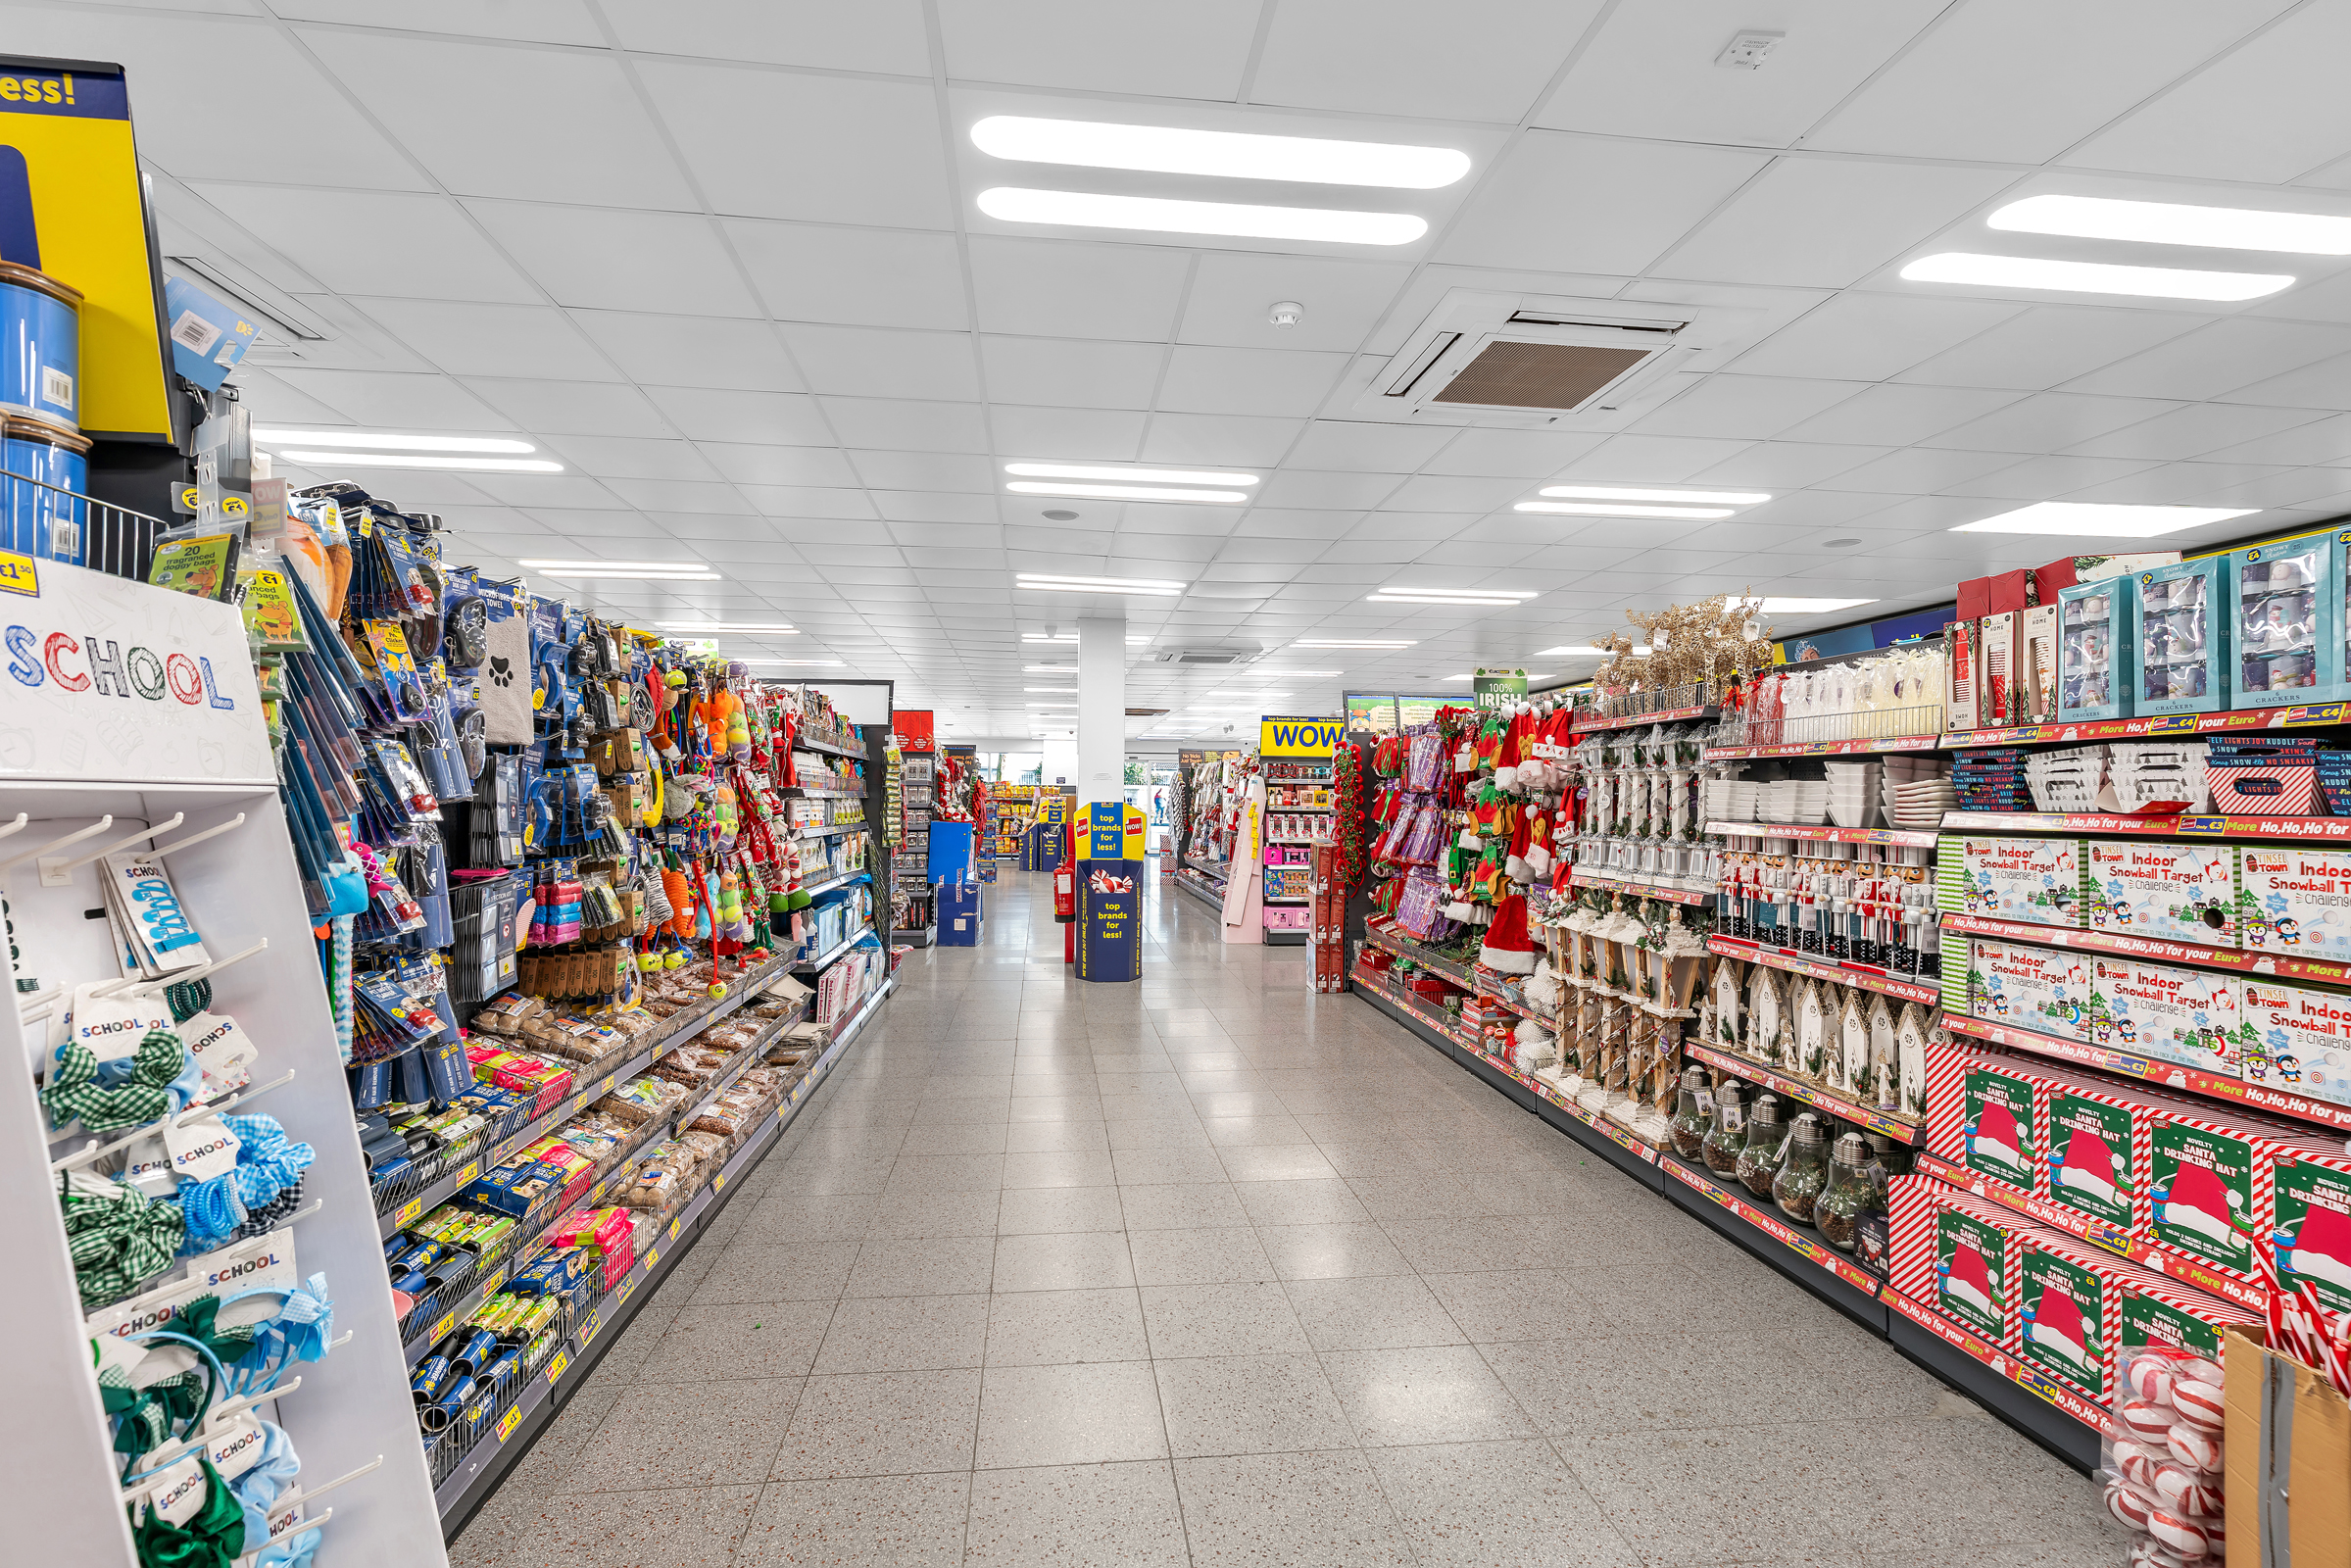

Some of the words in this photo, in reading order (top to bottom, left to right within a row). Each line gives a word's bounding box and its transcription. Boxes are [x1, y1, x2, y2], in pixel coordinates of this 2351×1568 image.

[184, 545, 201, 557] 20
[164, 562, 192, 571] doggy
[193, 558, 216, 566] bags
[166, 552, 216, 565] fragranced
[487, 599, 505, 610] TOWEL
[5, 624, 235, 710] SCHOOL
[1489, 683, 1513, 693] 100%
[1479, 693, 1522, 707] IRISH
[2256, 695, 2300, 704] CRACKERS
[2321, 708, 2339, 717] €4
[2099, 725, 2124, 734] More
[2180, 718, 2194, 727] €4
[2198, 716, 2226, 730] your
[2228, 716, 2256, 726] Euro
[1273, 725, 1345, 748] WOW
[1100, 815, 1114, 824] top
[2119, 819, 2142, 831] your
[2144, 819, 2168, 829] Euro
[1076, 824, 1089, 833] WOW!
[1093, 823, 1122, 832] brands
[2227, 821, 2257, 832] More
[2260, 821, 2323, 835] Ho,Ho,Ho
[2326, 821, 2349, 835] for
[1101, 833, 1113, 842] for
[1997, 846, 2034, 858] Indoor
[2101, 846, 2123, 855] TINSEL
[1980, 858, 2020, 870] Snowball
[2022, 860, 2056, 873] Target
[2132, 852, 2178, 867] Indoor
[125, 866, 163, 878] SCHOOL
[2001, 870, 2032, 881] Challenge
[2110, 866, 2158, 880] Snowball
[2161, 868, 2204, 884] Target
[2135, 880, 2174, 893] Challenge
[2270, 876, 2334, 894] Snowball
[1105, 903, 1120, 911] top
[2003, 925, 2024, 935] your
[2024, 927, 2044, 937] Euro
[2115, 939, 2165, 954] Ho,Ho,Ho
[2166, 944, 2184, 956] for
[2185, 949, 2213, 960] your
[2213, 952, 2241, 963] Euro
[1870, 981, 1886, 990] More
[2137, 972, 2183, 991] Indoor
[2114, 983, 2163, 1001] Snowball
[2167, 991, 2210, 1009] Target
[2258, 988, 2287, 1001] TINSEL
[2140, 1001, 2180, 1015] Challenge
[2260, 999, 2289, 1009] TOWN
[81, 1018, 144, 1038] SCHOOL
[2047, 1040, 2089, 1059] Ho,Ho,Ho
[1740, 1065, 1750, 1075] your
[2131, 1062, 2144, 1072] €3
[1988, 1081, 2007, 1090] NOVELTY
[1986, 1087, 2010, 1101] SANTA
[2213, 1081, 2244, 1097] More
[2245, 1088, 2308, 1112] Ho,Ho,Ho
[2310, 1102, 2333, 1118] for
[1974, 1090, 2007, 1107] DRINKING
[2009, 1101, 2025, 1113] HAT
[2186, 1137, 2213, 1150] NOVELTY
[176, 1137, 234, 1165] SCHOOL
[2182, 1143, 2217, 1162] SANTA
[2164, 1147, 2213, 1170] DRINKING
[2215, 1161, 2238, 1178] HAT
[1946, 1169, 1964, 1183] Euro
[2289, 1187, 2350, 1215] DRINKING
[2003, 1193, 2026, 1208] More
[2026, 1201, 2069, 1227] Ho,Ho,Ho
[2071, 1218, 2085, 1234] for
[2113, 1238, 2127, 1249] €8
[208, 1253, 280, 1286] SCHOOL
[2049, 1264, 2072, 1278] NOVELTY
[2046, 1270, 2075, 1290] SANTA
[2032, 1271, 2072, 1298] DRINKING
[2073, 1291, 2091, 1306] HAT
[2155, 1310, 2180, 1327] NOVELTY
[2132, 1317, 2180, 1348] DRINKING
[2151, 1317, 2184, 1340] SANTA
[1944, 1325, 1965, 1344] your
[1965, 1338, 1984, 1355] Euro
[2042, 1384, 2056, 1396] €8
[215, 1431, 262, 1463] SCHOOL
[160, 1472, 204, 1510] SCHOOL
